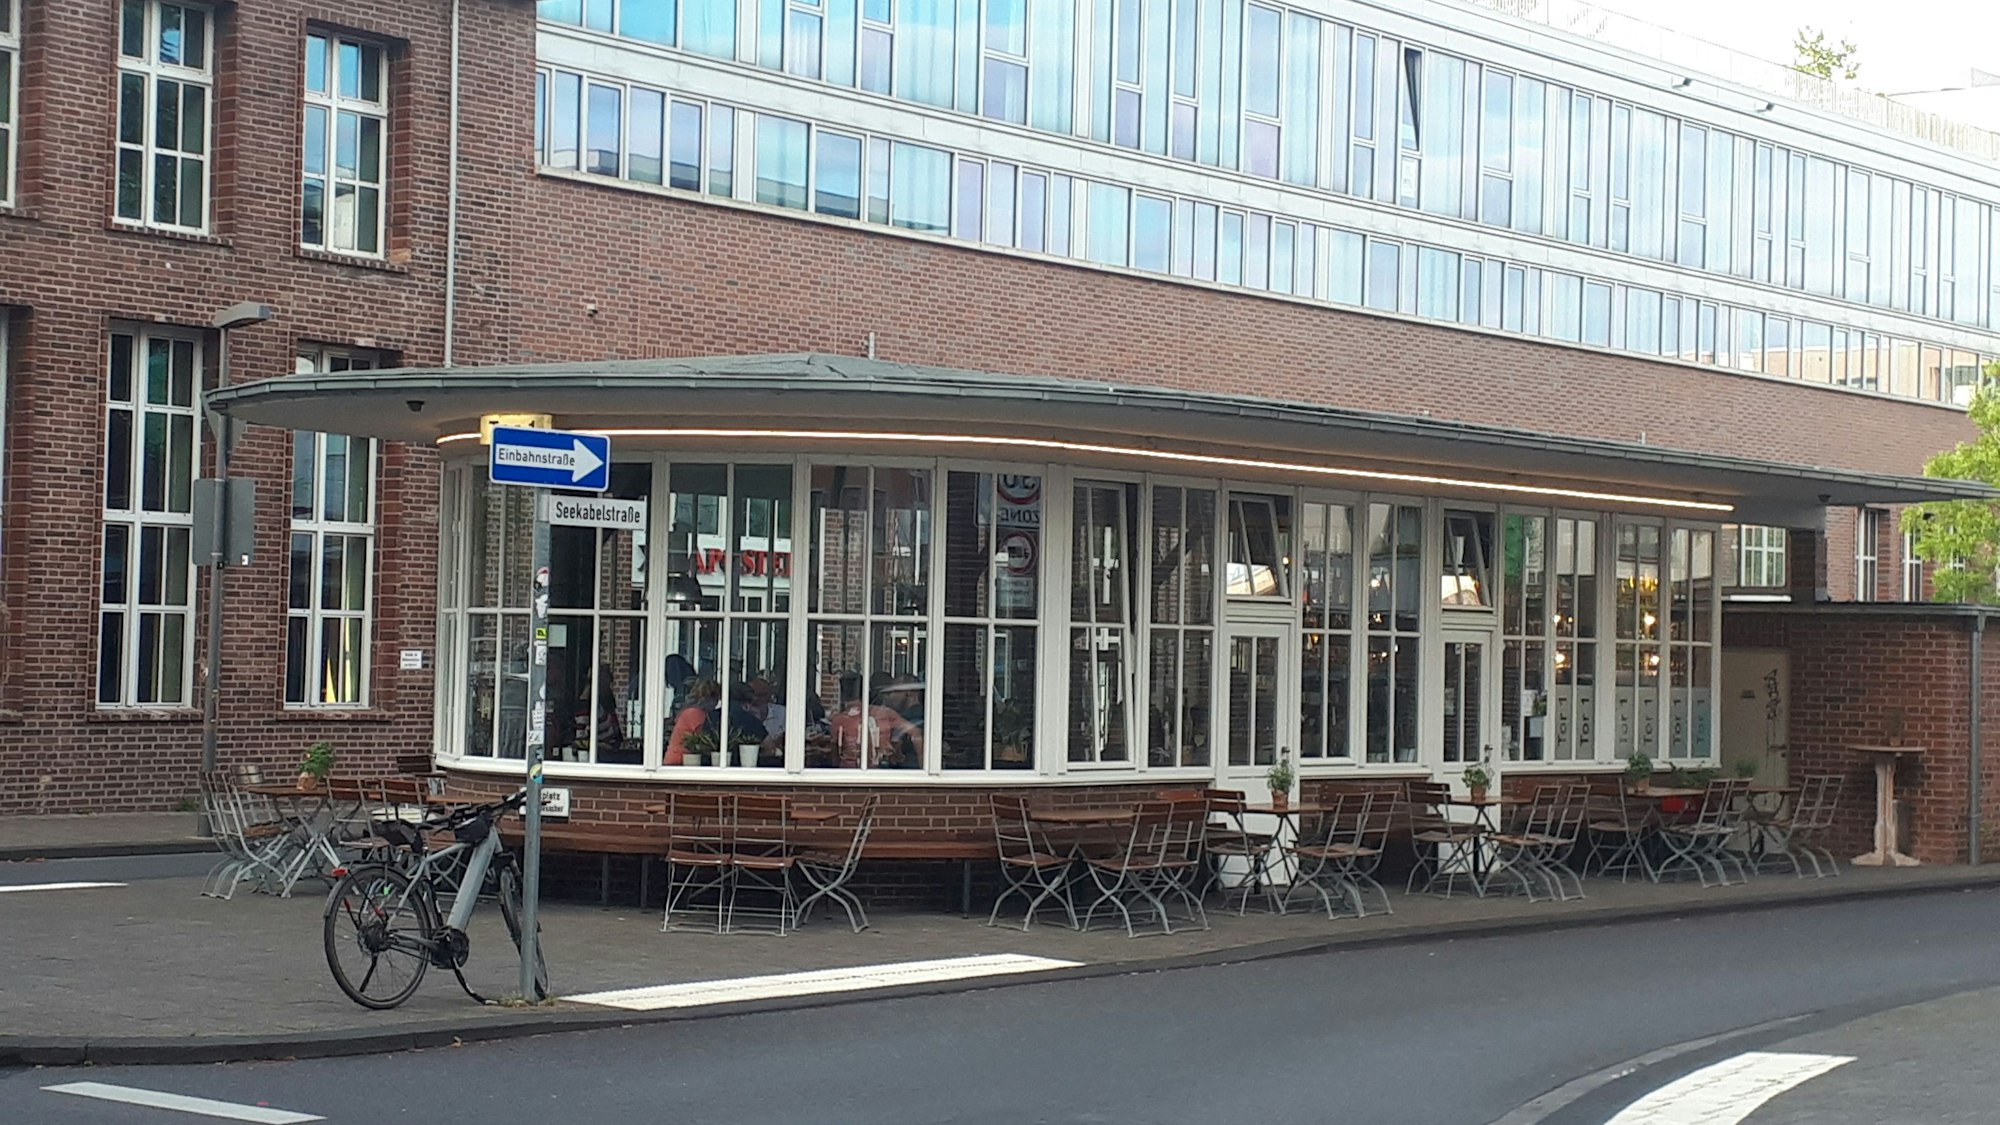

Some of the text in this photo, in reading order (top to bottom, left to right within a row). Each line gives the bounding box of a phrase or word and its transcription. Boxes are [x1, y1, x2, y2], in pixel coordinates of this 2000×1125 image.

[498, 447, 576, 467] Einbahnstraße
[555, 500, 641, 524] Seekabelstraße
[1557, 712, 1568, 747] Tor
[1580, 697, 1590, 748] Tor 1
[1643, 714, 1654, 746] Tor
[1672, 714, 1682, 746] Tor
